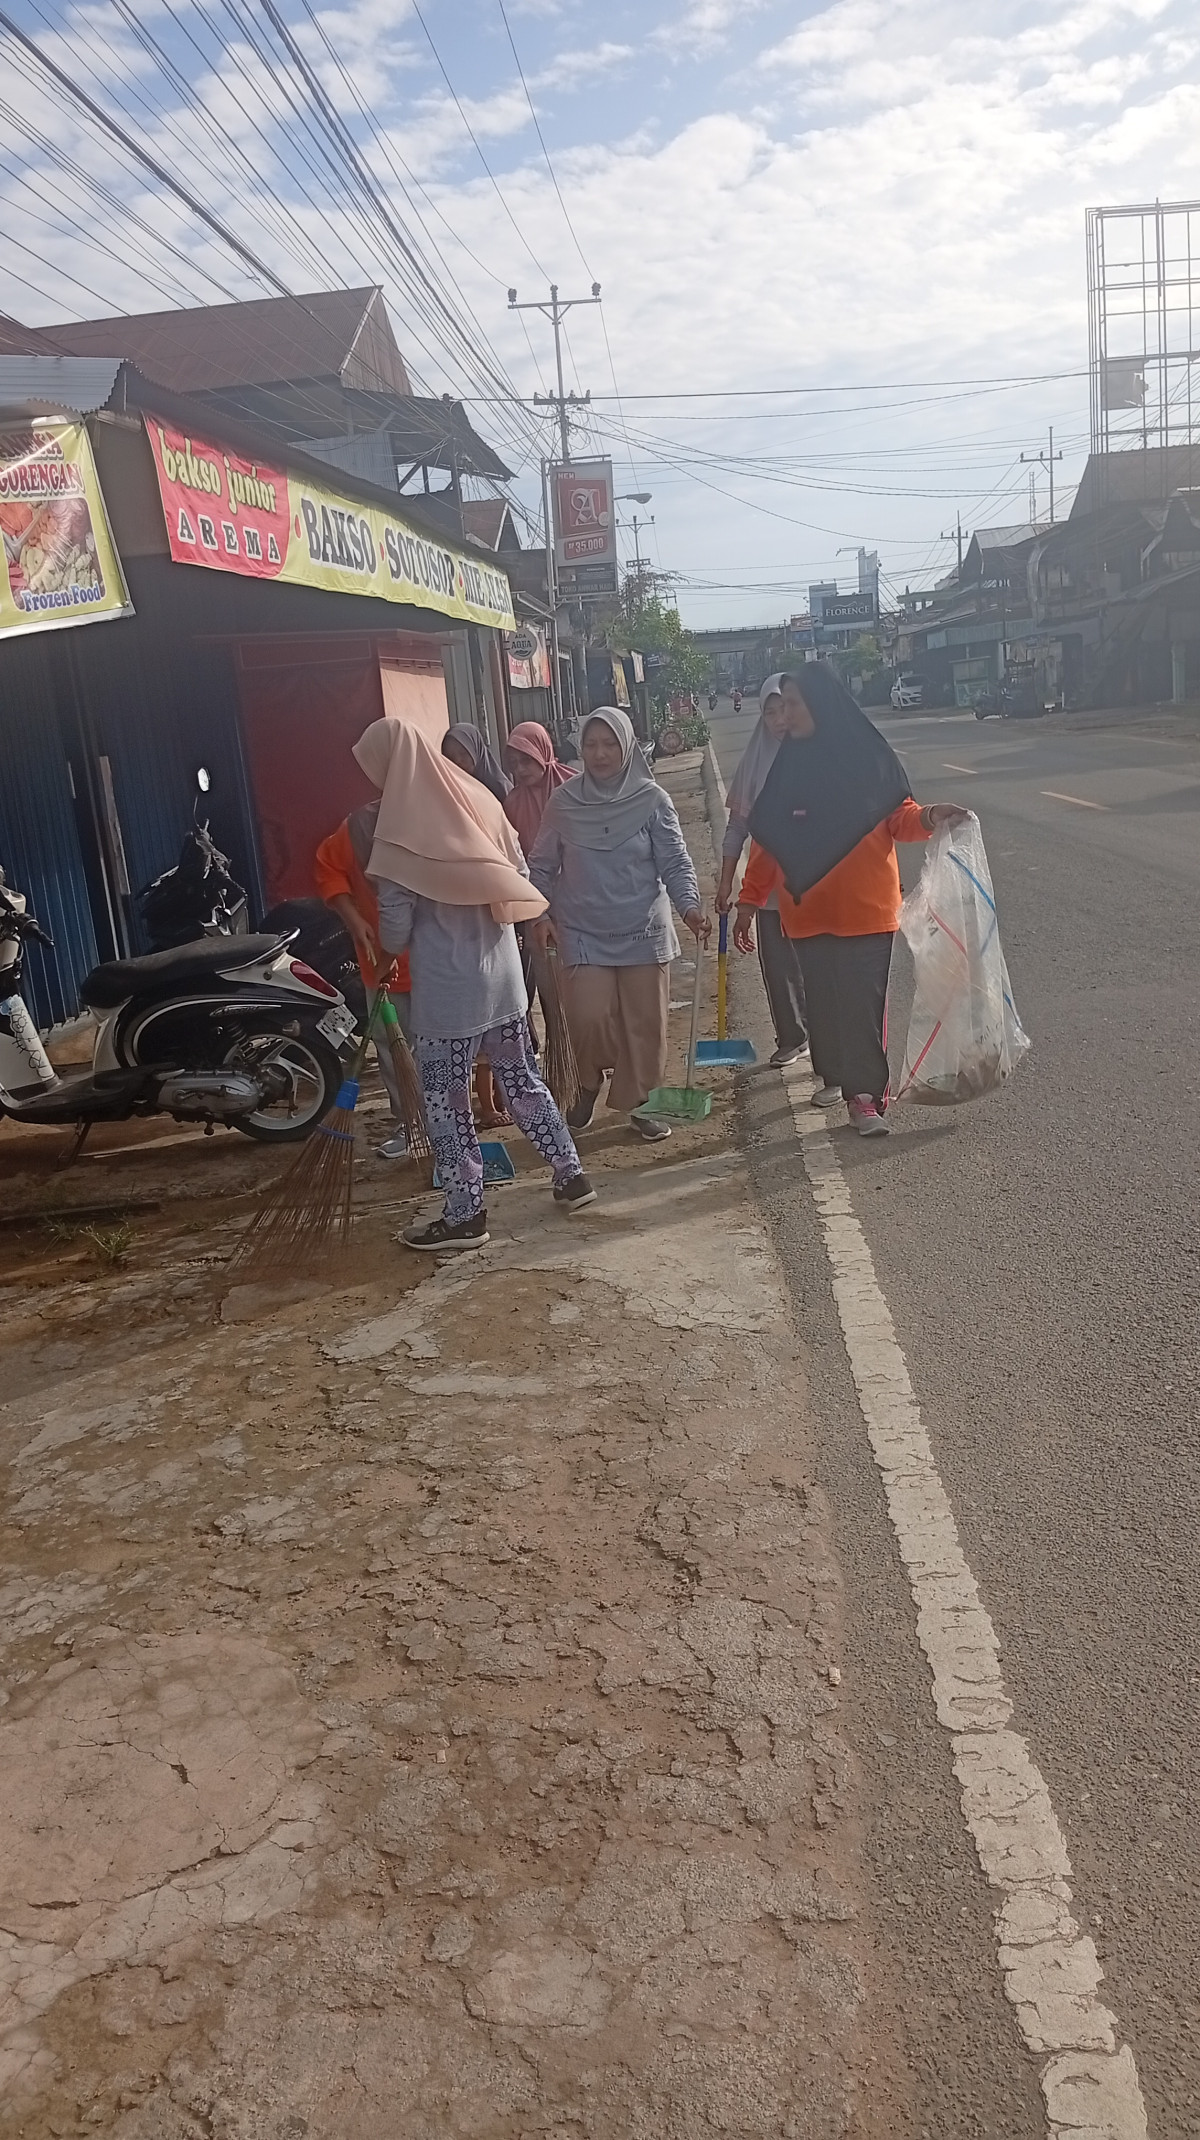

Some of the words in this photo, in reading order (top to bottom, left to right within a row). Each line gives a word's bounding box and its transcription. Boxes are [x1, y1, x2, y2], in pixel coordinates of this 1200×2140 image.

[158, 428, 222, 497] bakso
[224, 455, 277, 514] junior
[178, 508, 281, 563] AREMA
[301, 497, 377, 574] BAKSO
[575, 537, 604, 553] 35.000
[21, 590, 70, 612] Frozen
[70, 581, 102, 605] Food
[825, 605, 870, 617] FLORENCE
[511, 640, 532, 650] AQUA
